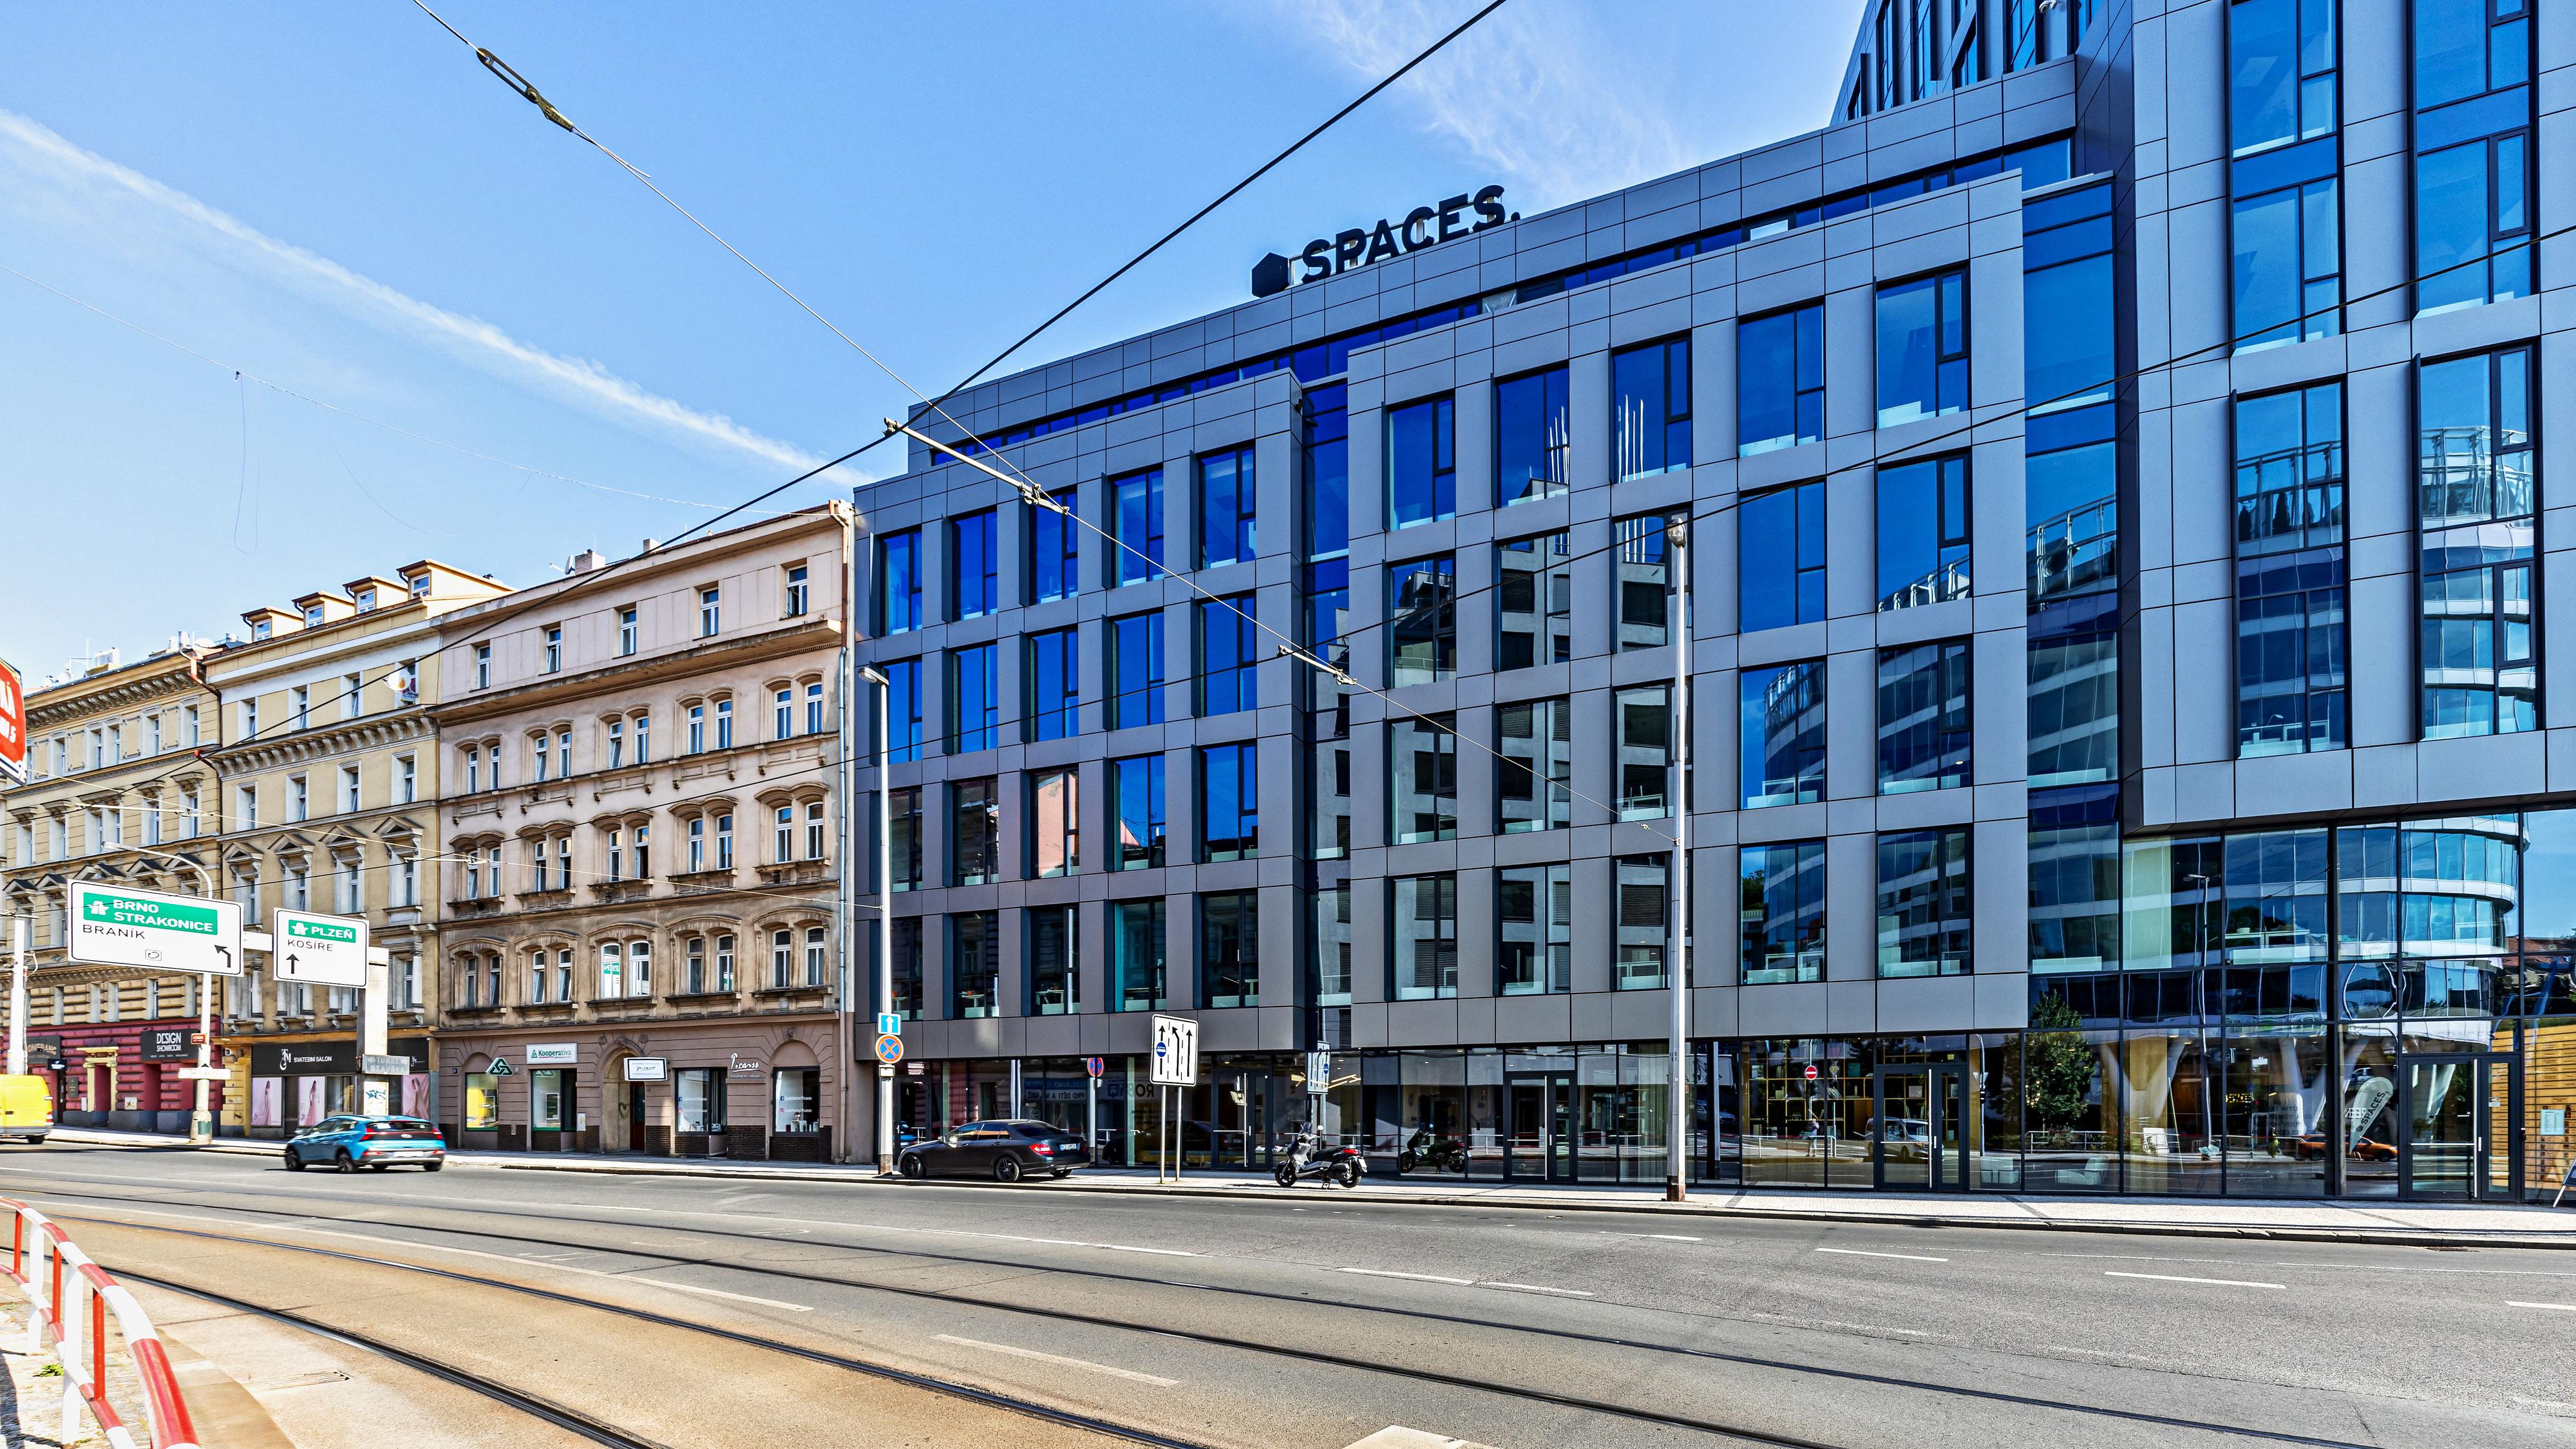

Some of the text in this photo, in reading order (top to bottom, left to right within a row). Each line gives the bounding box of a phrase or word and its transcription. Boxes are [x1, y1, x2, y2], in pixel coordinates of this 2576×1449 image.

[1301, 185, 1521, 285] SPACES.
[113, 899, 158, 913] BRNO
[114, 912, 214, 932] STRAKONICE
[82, 924, 145, 940] BRANÍK
[311, 926, 353, 940] PLZEŇ
[288, 940, 334, 952] KOŠÍŘE
[156, 1032, 182, 1044] DESIGN
[156, 1044, 182, 1052] SHOWROOM
[538, 1048, 571, 1057] Kooperativa
